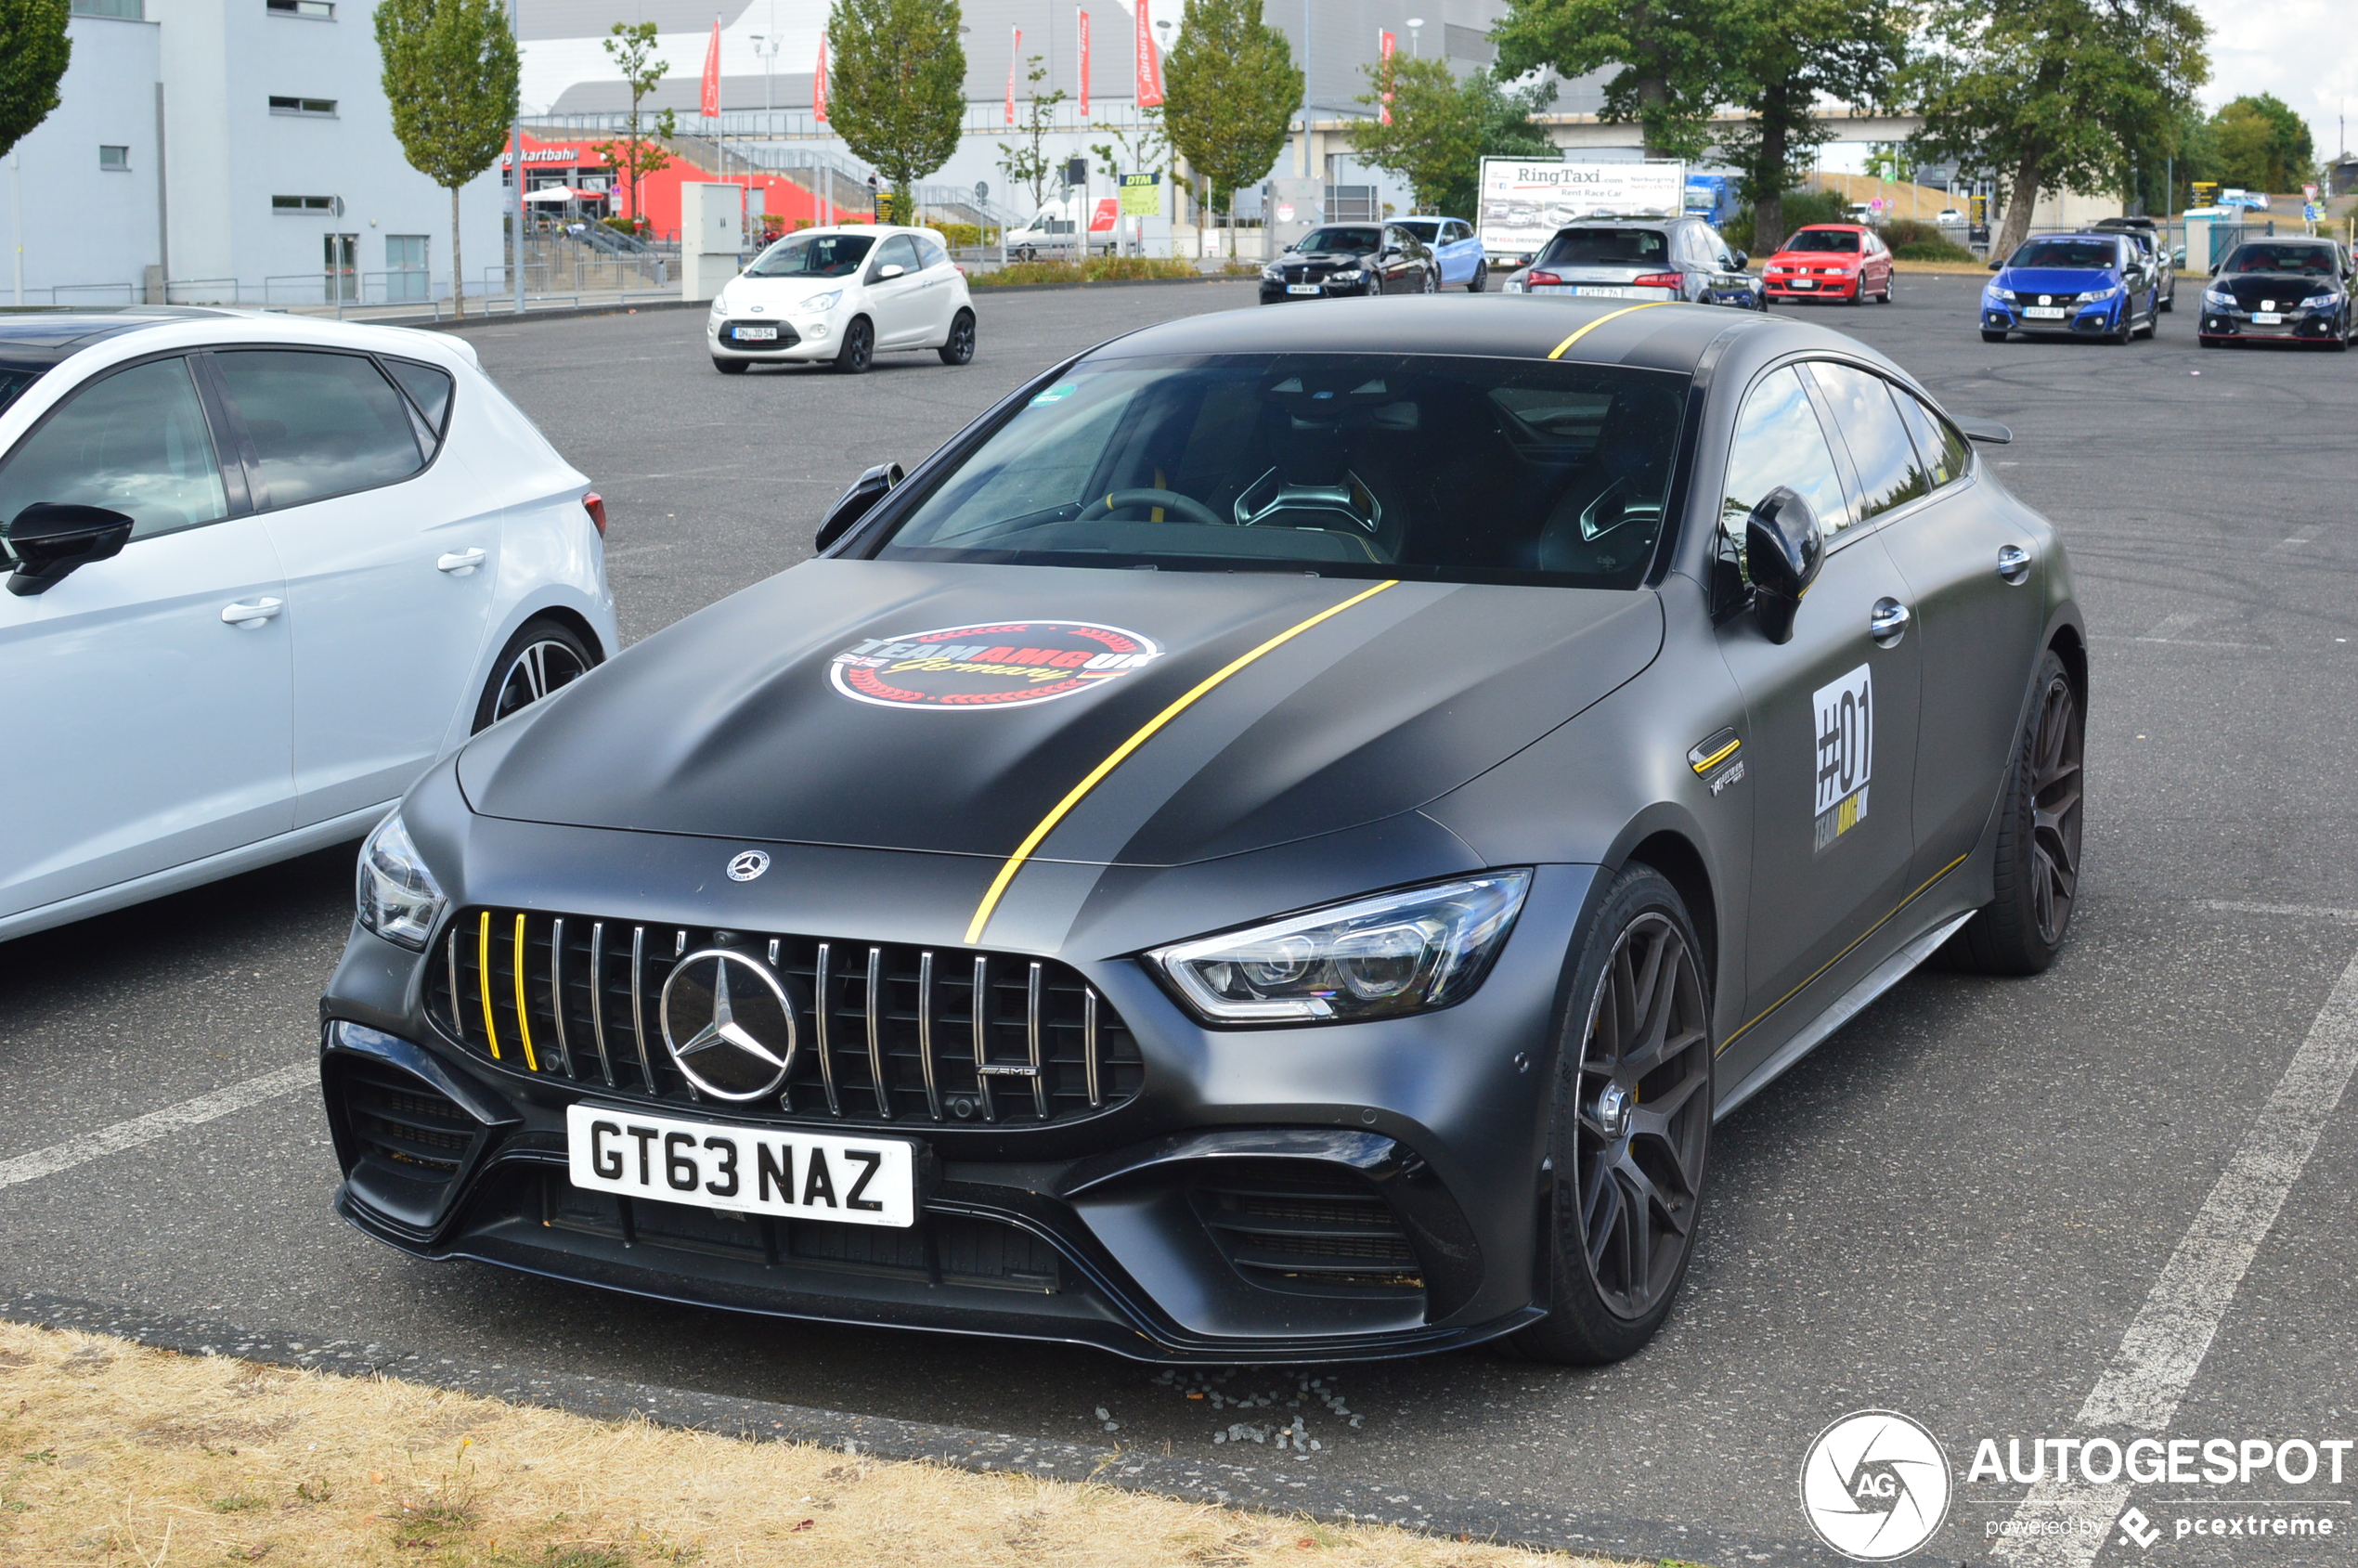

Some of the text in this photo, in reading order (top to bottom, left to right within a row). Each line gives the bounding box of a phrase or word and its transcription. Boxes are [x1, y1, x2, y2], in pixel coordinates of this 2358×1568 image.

[1126, 175, 1151, 186] DTM
[1561, 188, 1581, 197] Rent
[1608, 189, 1622, 198] Car
[881, 656, 1073, 683] Germany
[1819, 680, 1870, 809] #01
[996, 1067, 1037, 1075] AMG
[590, 1120, 884, 1212] GT63 NAZ
